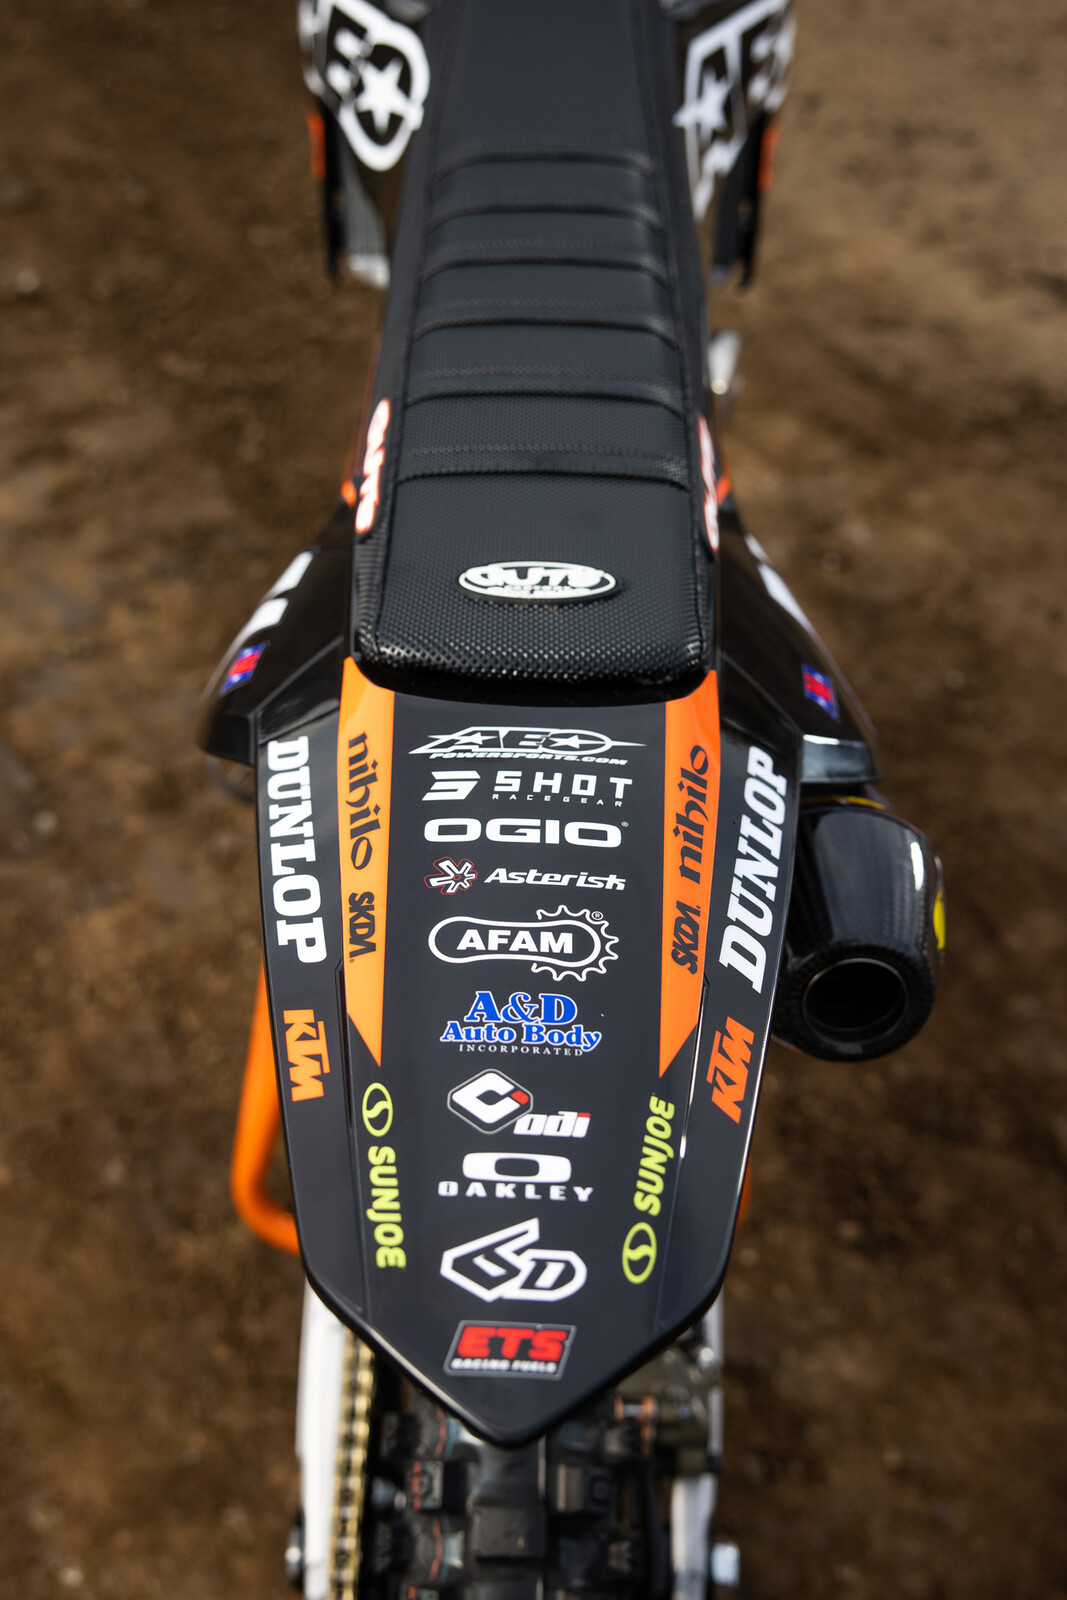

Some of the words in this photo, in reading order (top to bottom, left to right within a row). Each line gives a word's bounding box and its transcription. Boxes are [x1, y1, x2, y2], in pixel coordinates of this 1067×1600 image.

[429, 752, 628, 765] POWERSPORTS.COM
[346, 731, 381, 870] nihilo
[494, 770, 633, 799] SHOT
[672, 744, 709, 885] nihilo
[267, 735, 328, 963] DUNLOP
[424, 818, 622, 848] OGIO
[484, 867, 627, 891] Asterisk
[719, 745, 788, 994] DUNLOP
[456, 929, 573, 954] AFAM
[464, 991, 578, 1025] A&D
[440, 1020, 517, 1043] Auto
[521, 1022, 602, 1052] Body
[459, 1044, 584, 1056] INCORPORATED
[282, 1009, 331, 1102] KTM
[706, 1016, 755, 1124] KTM
[513, 1111, 591, 1138] odi
[633, 1095, 675, 1217] SUNJOE
[366, 1146, 407, 1269] SUNJOE
[438, 1181, 593, 1202] OAKLEY
[457, 1326, 567, 1362] ETS
